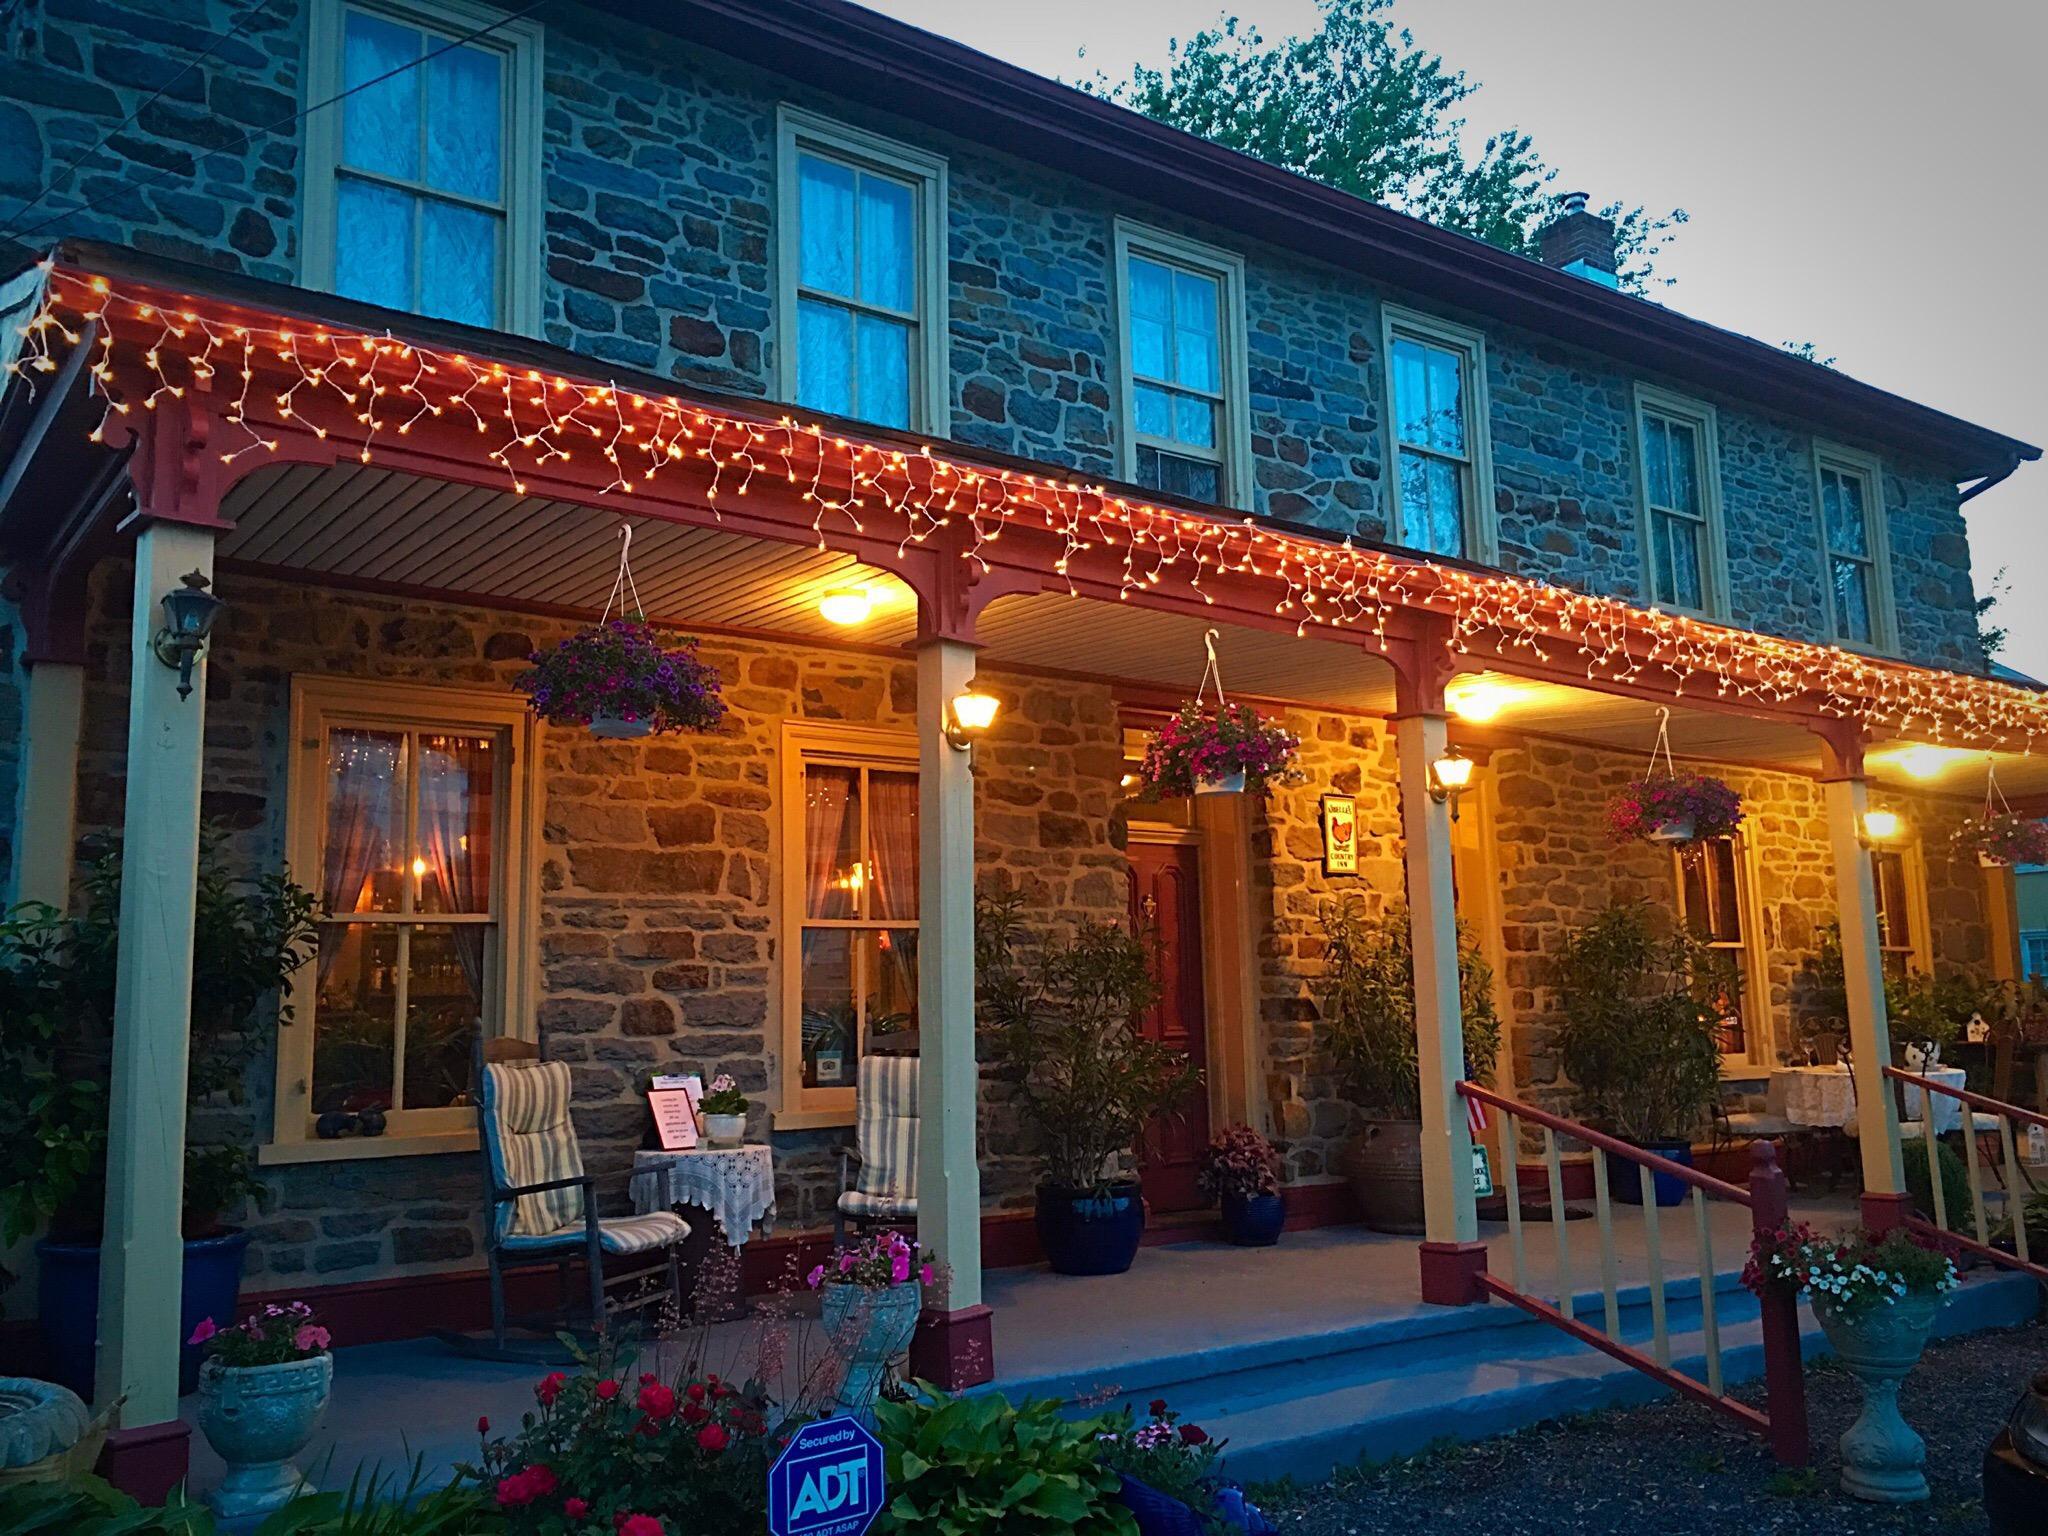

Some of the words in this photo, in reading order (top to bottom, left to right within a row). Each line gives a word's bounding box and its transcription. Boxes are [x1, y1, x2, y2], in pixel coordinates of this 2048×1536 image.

[799, 1430, 842, 1450] Secured
[843, 1429, 855, 1441] by
[790, 1457, 867, 1520] ADT
[835, 1520, 859, 1534] ASAP
